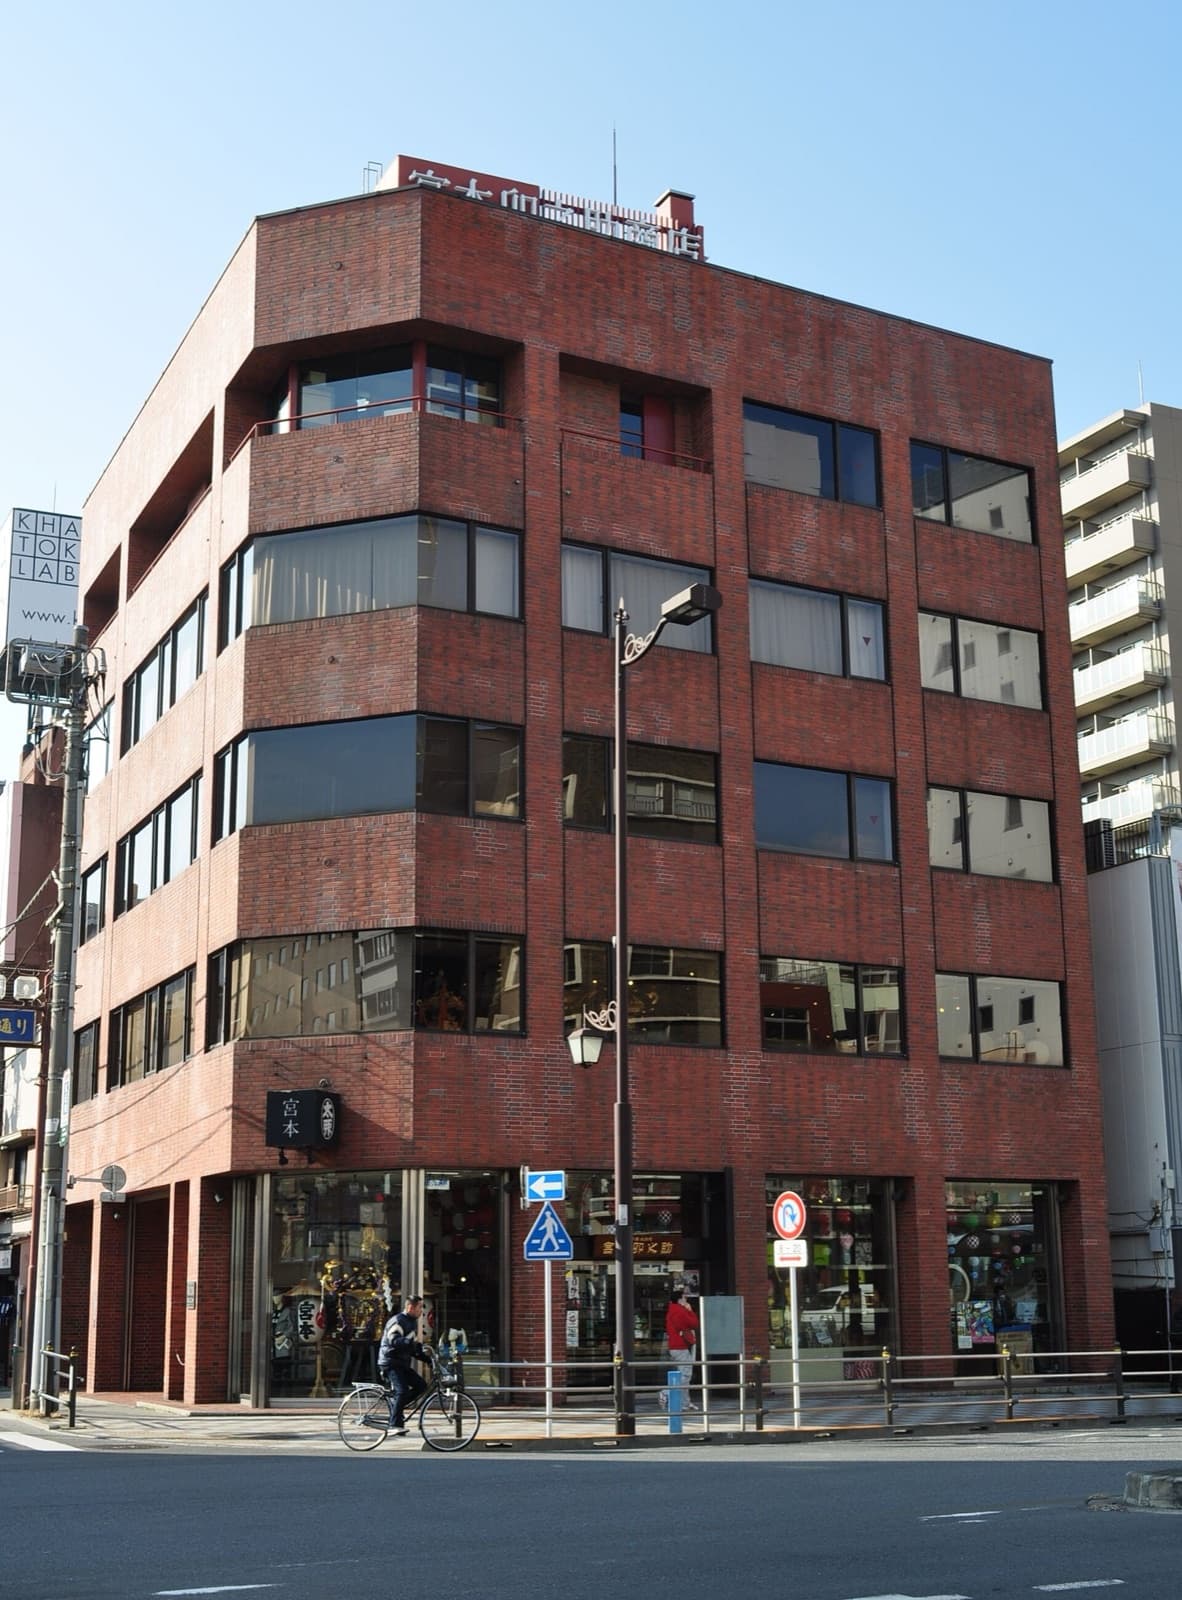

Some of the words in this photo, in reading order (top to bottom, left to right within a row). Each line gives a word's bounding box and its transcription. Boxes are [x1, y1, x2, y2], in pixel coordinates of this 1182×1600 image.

[19, 536, 76, 560] TOK
[19, 559, 75, 582] LAB
[282, 1098, 300, 1139] 宮本
[602, 1241, 673, 1254] 宮卯之助
[299, 1301, 315, 1339] 宮本
